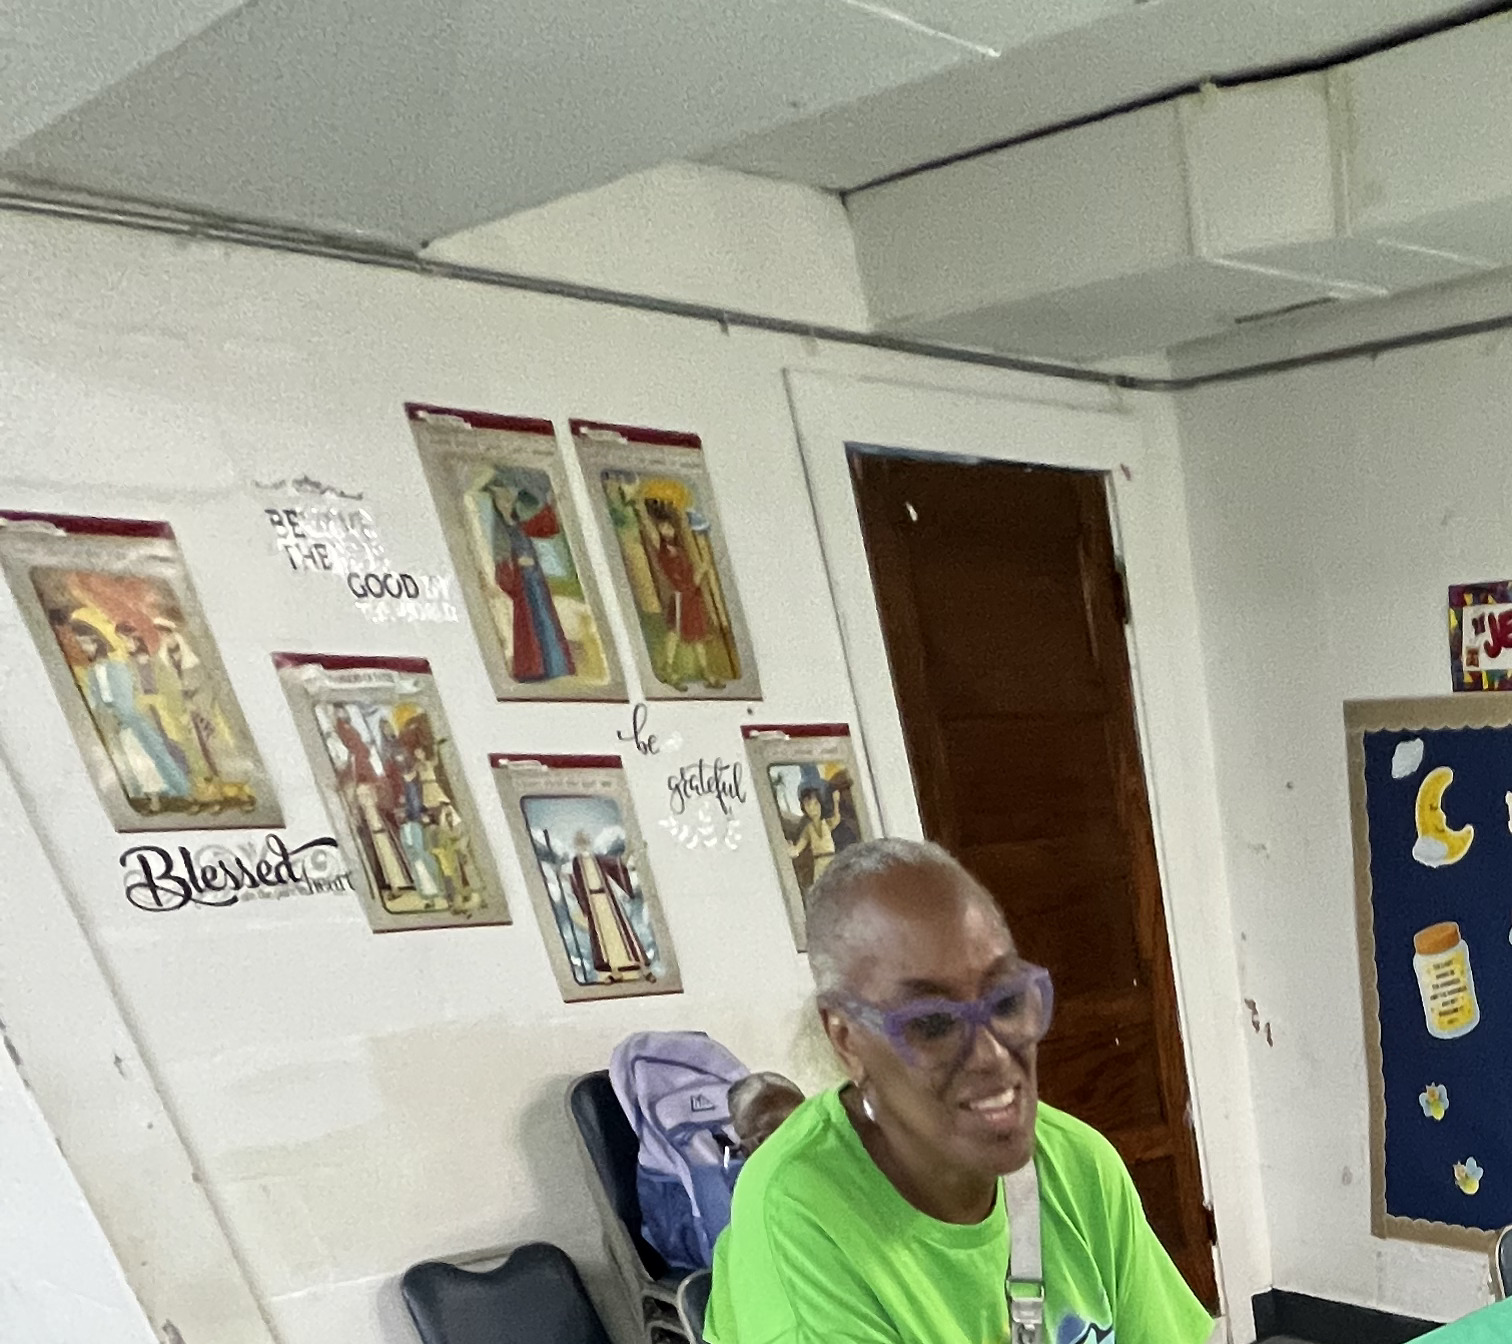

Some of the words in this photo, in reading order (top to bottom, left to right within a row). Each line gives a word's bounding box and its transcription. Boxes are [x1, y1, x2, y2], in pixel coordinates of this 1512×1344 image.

[346, 572, 419, 599] GOOD
[617, 702, 660, 755] be
[667, 757, 746, 815] grateful
[120, 834, 338, 912] Blessed
